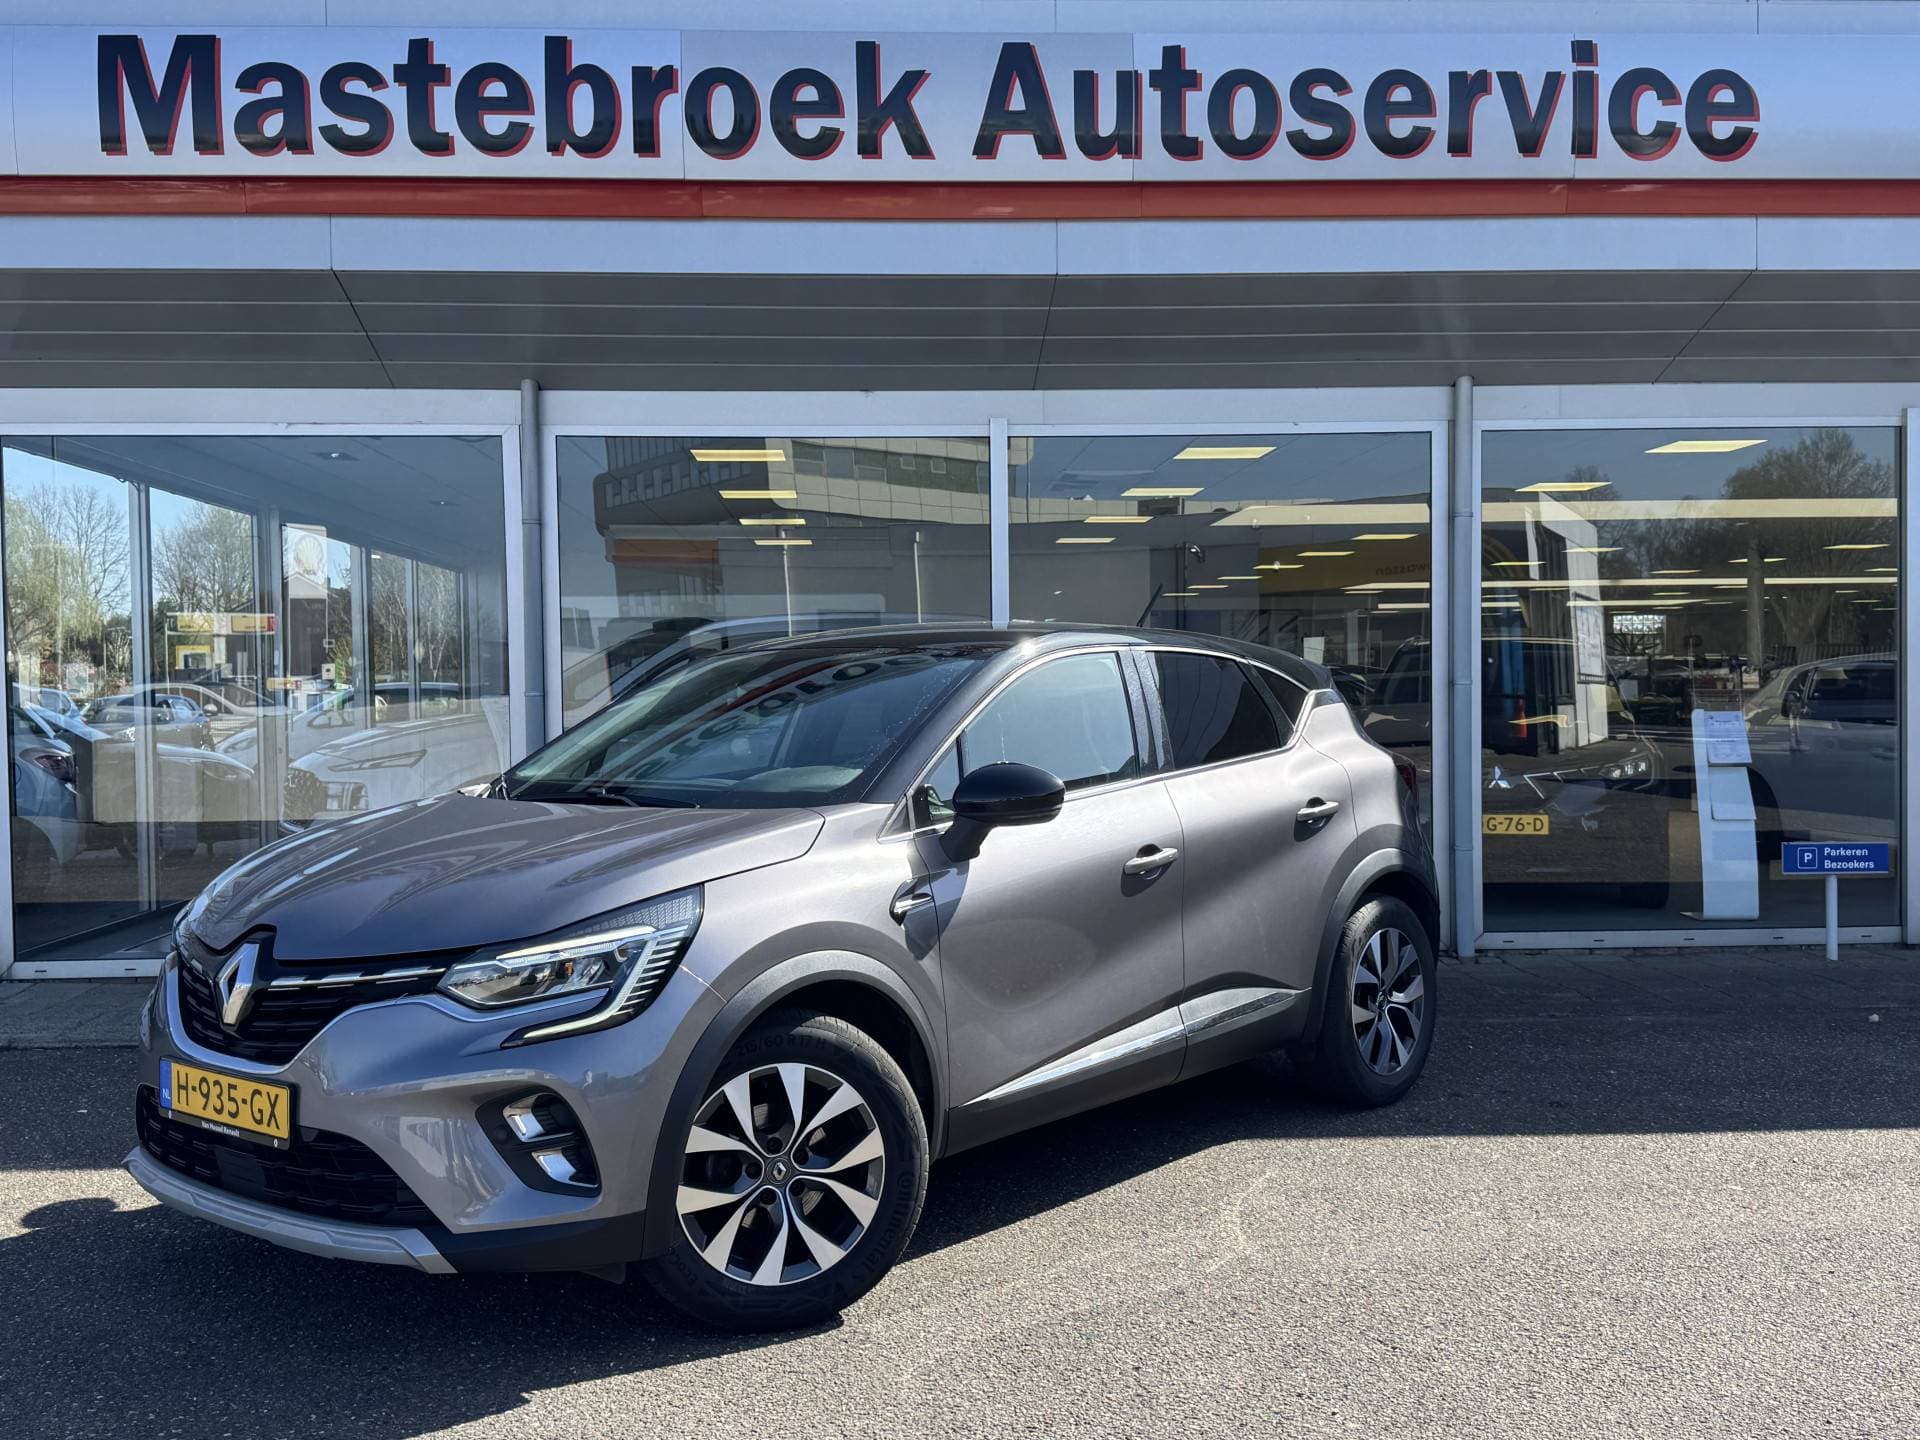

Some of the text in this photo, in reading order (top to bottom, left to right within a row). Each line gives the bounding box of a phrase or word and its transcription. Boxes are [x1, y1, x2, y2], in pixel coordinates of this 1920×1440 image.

[97, 34, 1761, 162] Mastebroek Autoservice
[1482, 816, 1544, 832] G-76-D
[1824, 847, 1868, 856] Parkeren
[1804, 852, 1813, 863] P
[1824, 860, 1875, 869] Bezoekers
[162, 1088, 171, 1099] NL
[176, 1069, 281, 1131] H-935-GX
